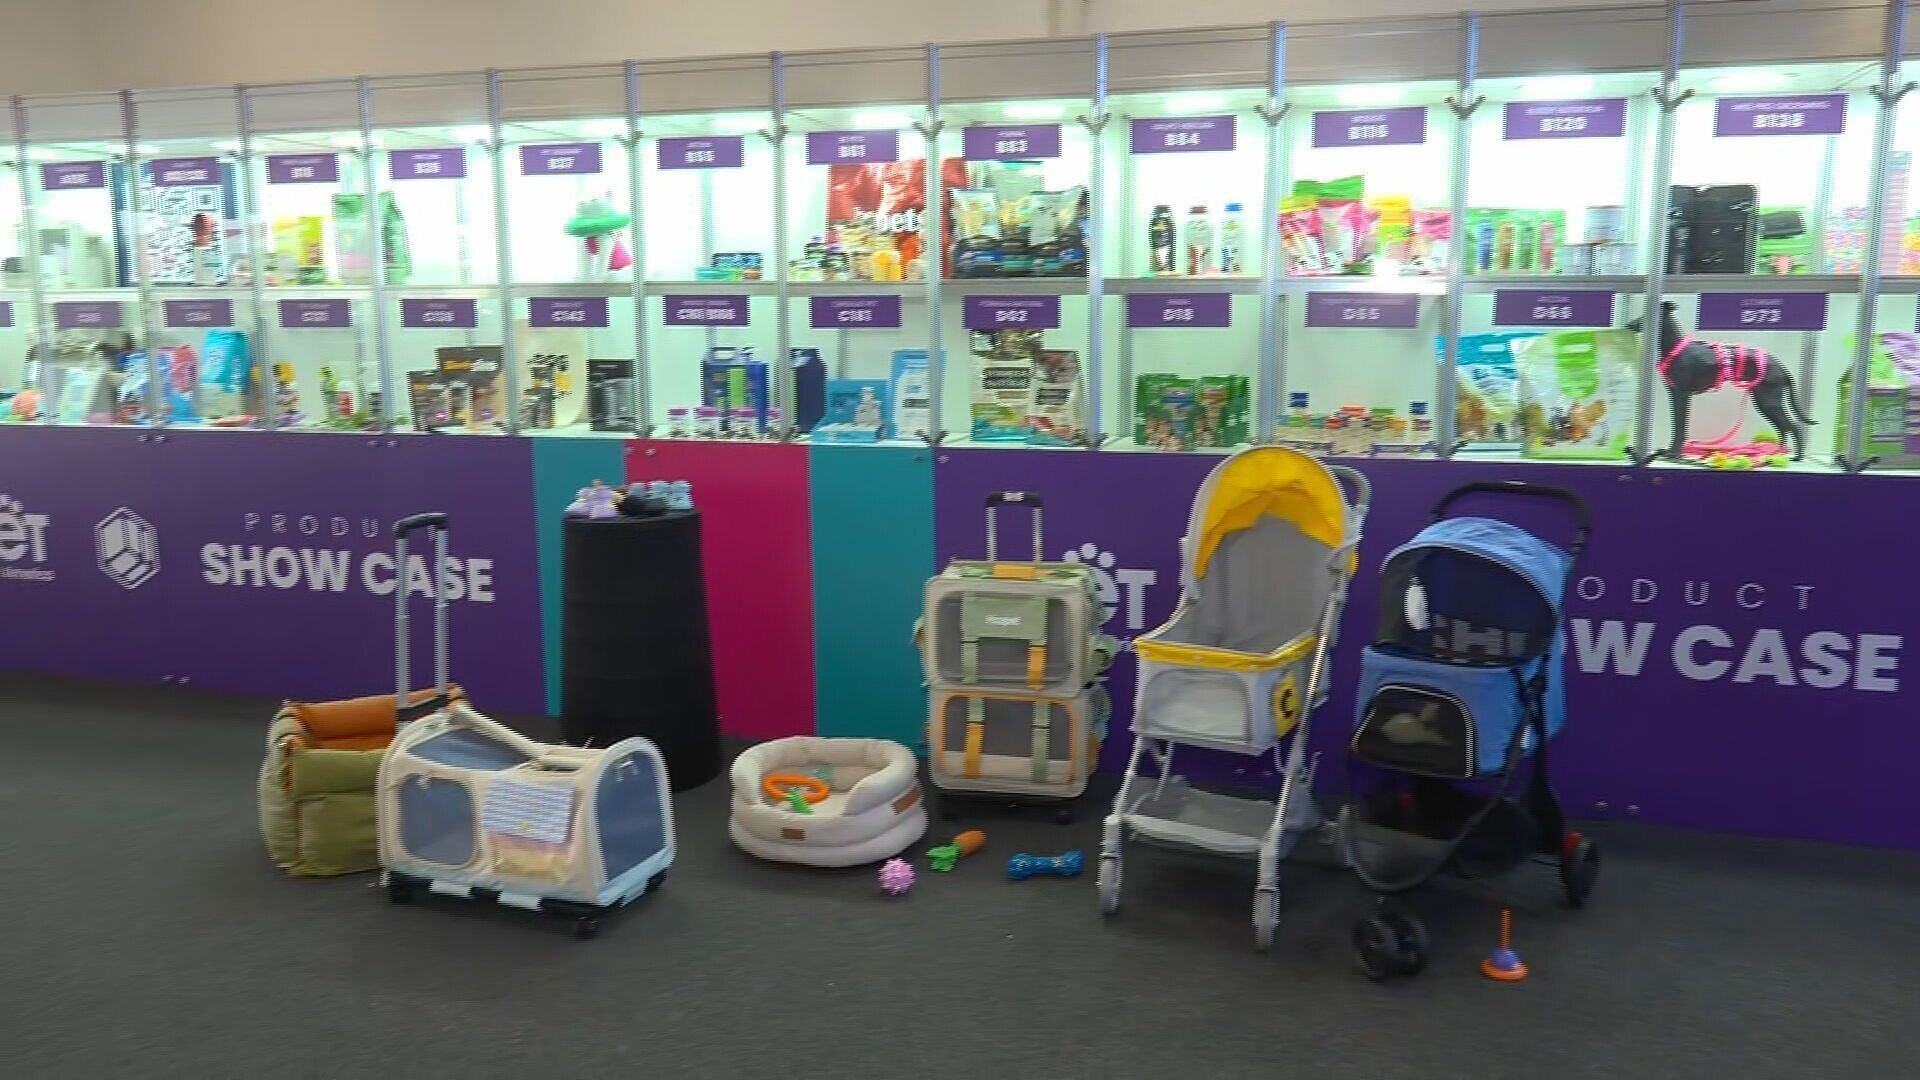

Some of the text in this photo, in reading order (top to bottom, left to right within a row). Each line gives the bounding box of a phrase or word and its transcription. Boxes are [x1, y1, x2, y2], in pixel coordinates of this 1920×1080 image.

[1541, 116, 1587, 132] B120
[1166, 132, 1199, 146] B84
[996, 140, 1027, 154] B83
[996, 310, 1027, 322] D02
[1164, 308, 1193, 321] D18
[1343, 308, 1379, 321] D65
[1533, 306, 1571, 320] D66
[1743, 309, 1780, 322] D73
[200, 542, 496, 602] SHOW CASE
[1671, 624, 1904, 692] CASE
